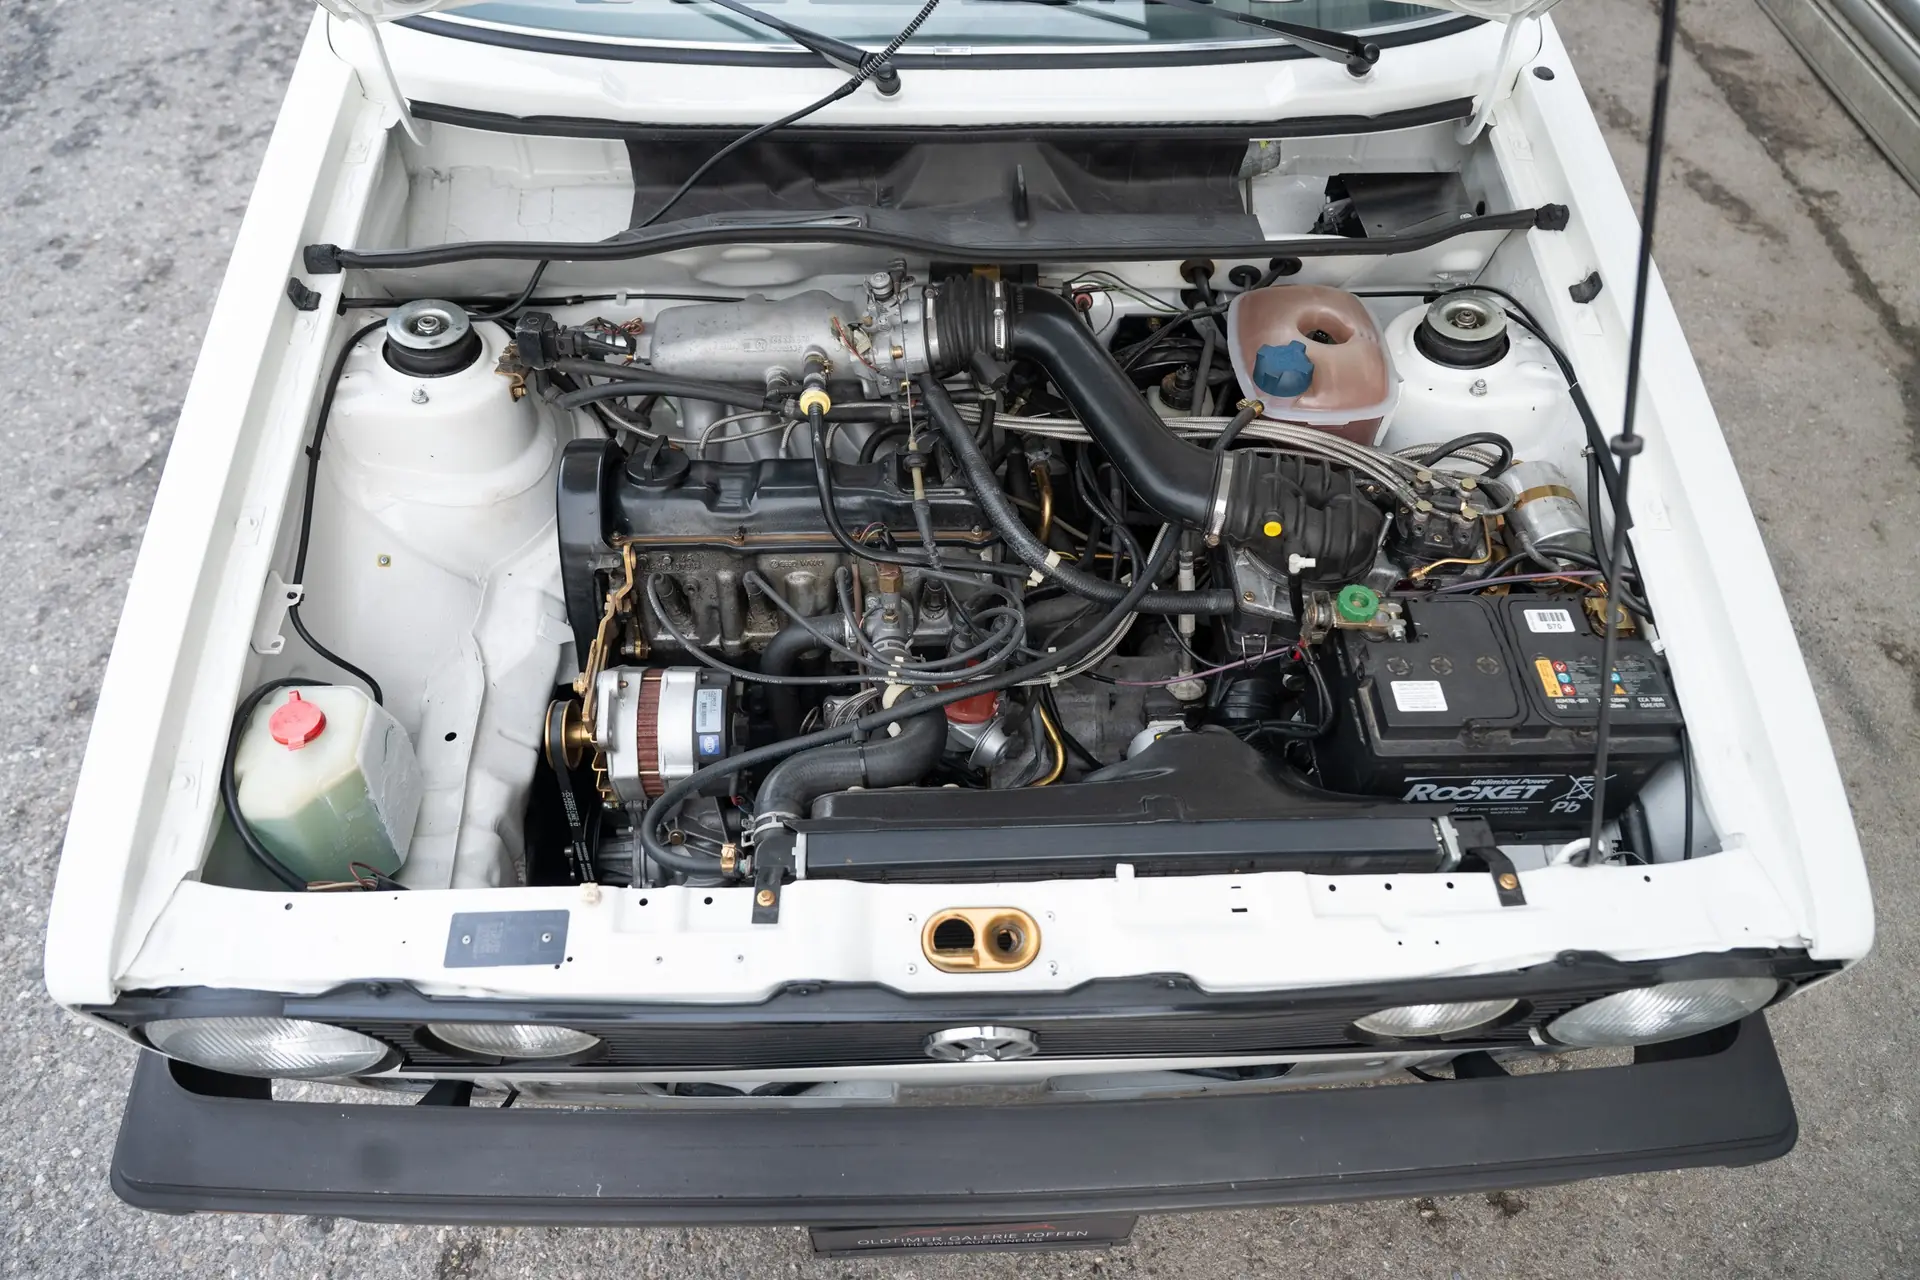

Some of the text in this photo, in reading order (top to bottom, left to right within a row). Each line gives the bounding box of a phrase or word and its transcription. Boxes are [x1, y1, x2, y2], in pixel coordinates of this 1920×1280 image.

[1470, 778, 1519, 786] Unlimited
[1402, 784, 1548, 801] ROCKET
[1548, 801, 1582, 814] Pb
[857, 1230, 1089, 1246] OLDTIMER GALERIE TOFFEN
[964, 1237, 1044, 1246] AUCTIONEERS
